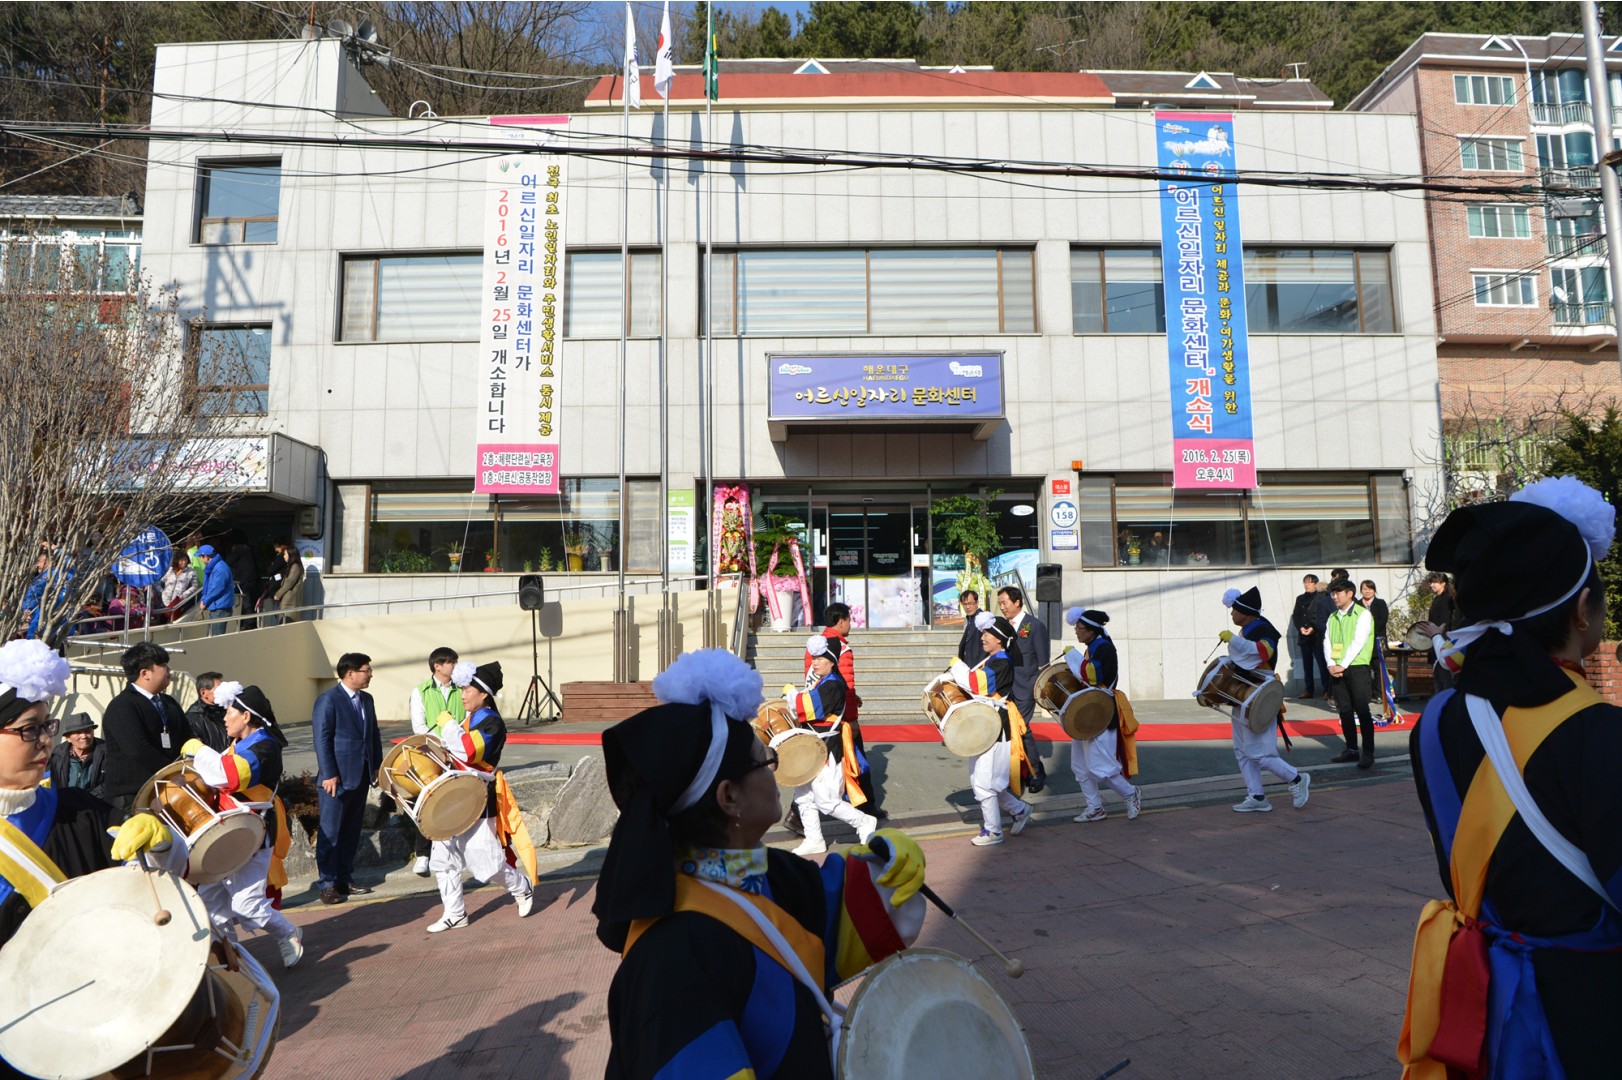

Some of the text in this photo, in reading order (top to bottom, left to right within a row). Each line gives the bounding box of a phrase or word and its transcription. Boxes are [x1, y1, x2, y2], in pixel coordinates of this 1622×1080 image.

[515, 174, 537, 371] 어르신일자리 문화센터가
[1216, 258, 1231, 293] 제공과
[489, 190, 511, 434] 2016년 2월 25일 개소합니다
[539, 165, 560, 436] 전국 최초 노인일자리와 주민생활서비스 동시 제공
[795, 385, 977, 407] 어르신일자리 문화센터
[1187, 379, 1212, 433] 개소식
[1223, 390, 1238, 415] 위한
[1183, 450, 1250, 464] 2016. 2. 25(목)
[1196, 468, 1234, 481] 오후4시
[1056, 511, 1074, 520] 158
[130, 532, 159, 543] 사로
